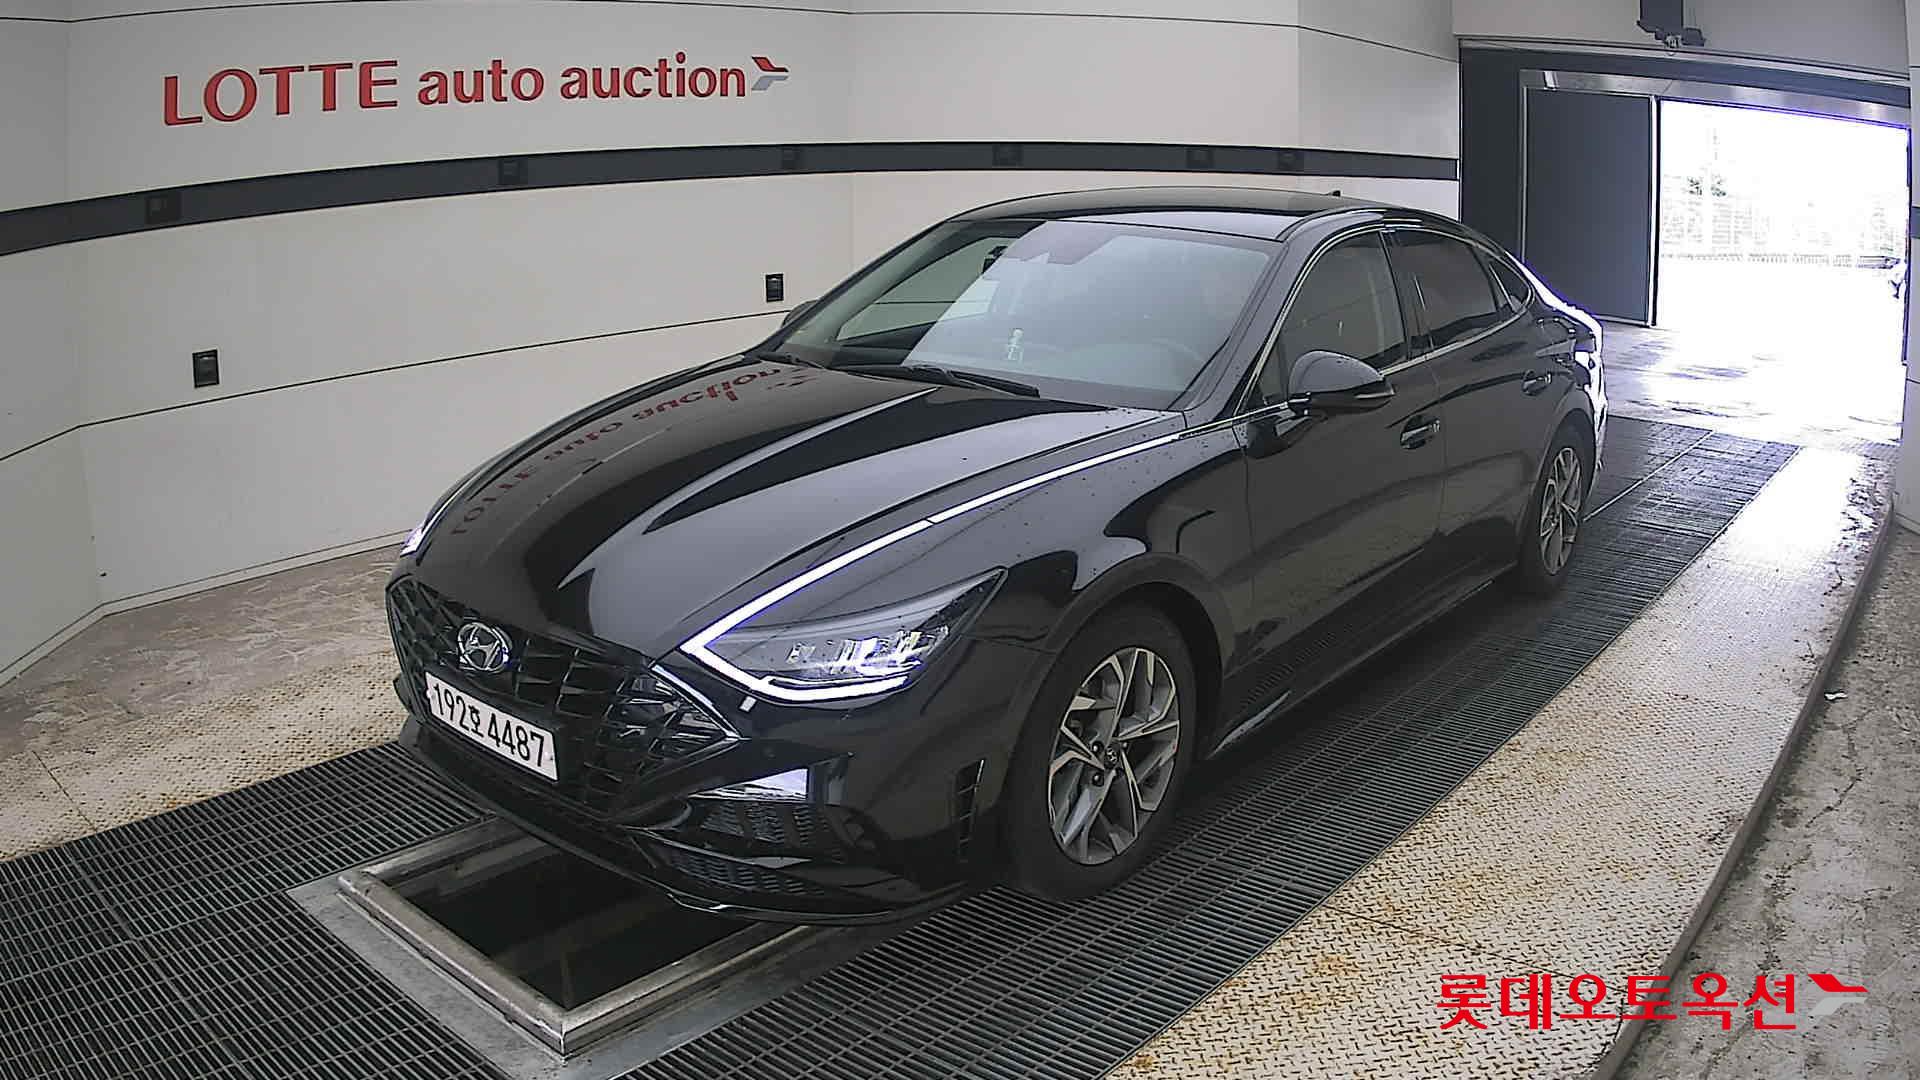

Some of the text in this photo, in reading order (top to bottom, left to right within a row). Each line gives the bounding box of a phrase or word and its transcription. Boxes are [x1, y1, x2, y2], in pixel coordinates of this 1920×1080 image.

[163, 52, 747, 126] LOTTE auto auction
[487, 713, 546, 767] 4487
